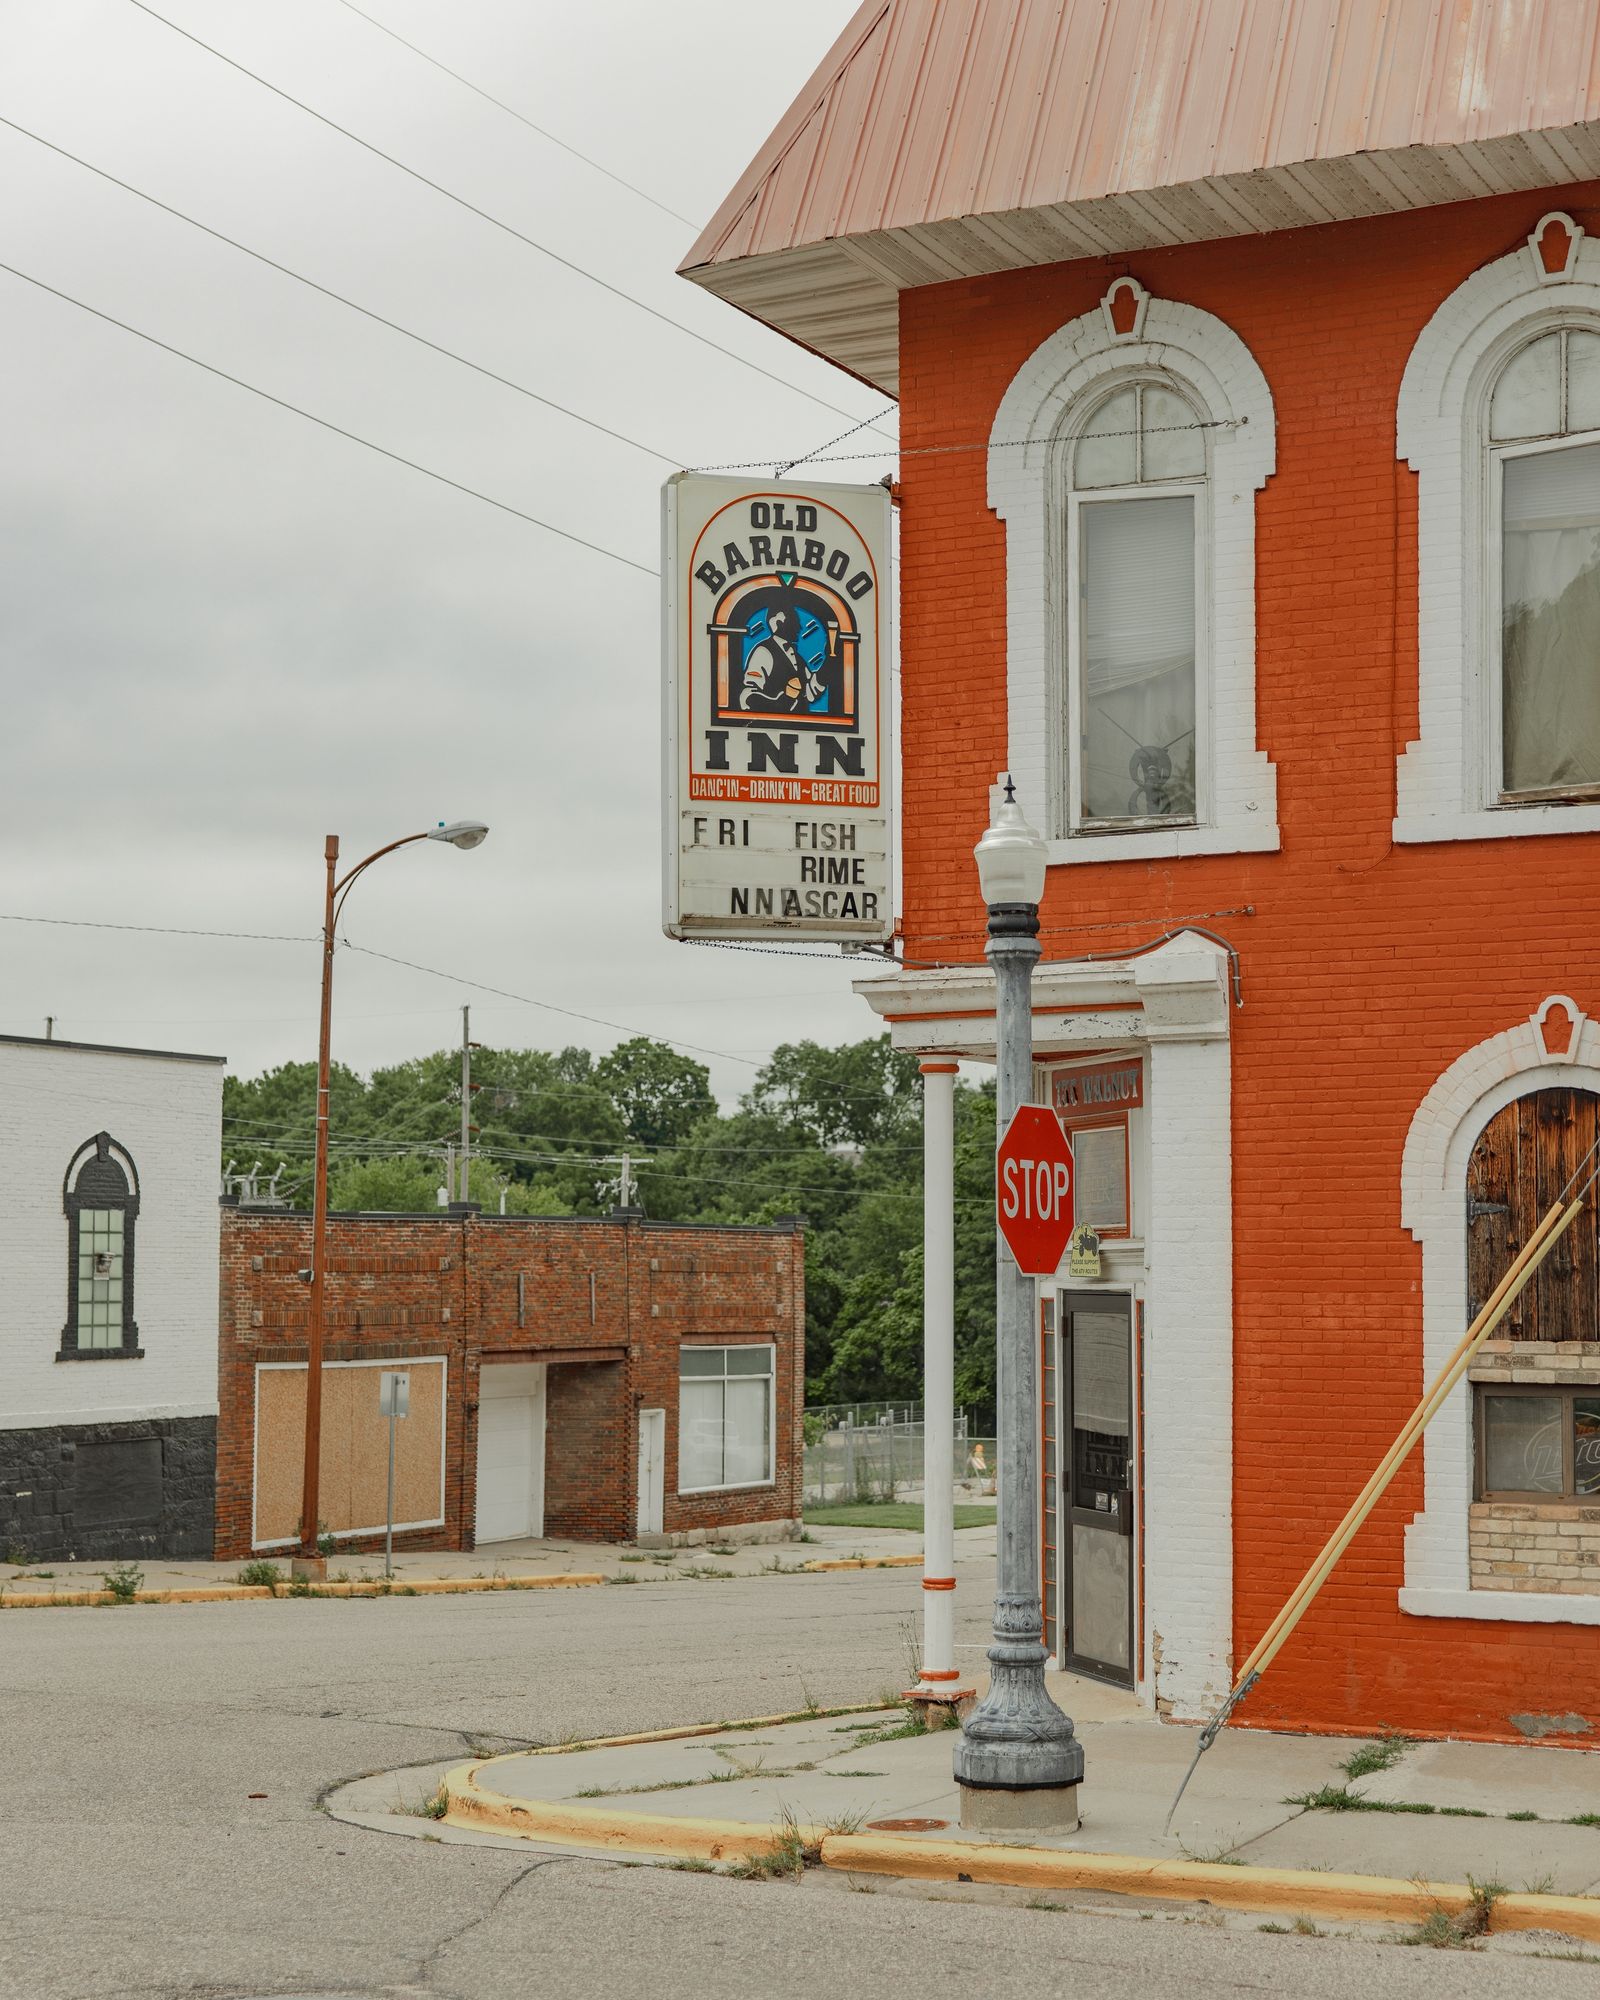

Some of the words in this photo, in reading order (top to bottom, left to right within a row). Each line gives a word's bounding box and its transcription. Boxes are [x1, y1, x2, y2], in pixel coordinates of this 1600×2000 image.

[751, 502, 817, 532] OLD
[695, 535, 874, 600] BARABOO
[705, 730, 865, 776] INN
[849, 785, 877, 804] FOOD
[795, 821, 856, 850] FISH
[801, 855, 865, 885] RIME
[1081, 1069, 1139, 1104] WALNUT
[1003, 1157, 1070, 1221] STOP
